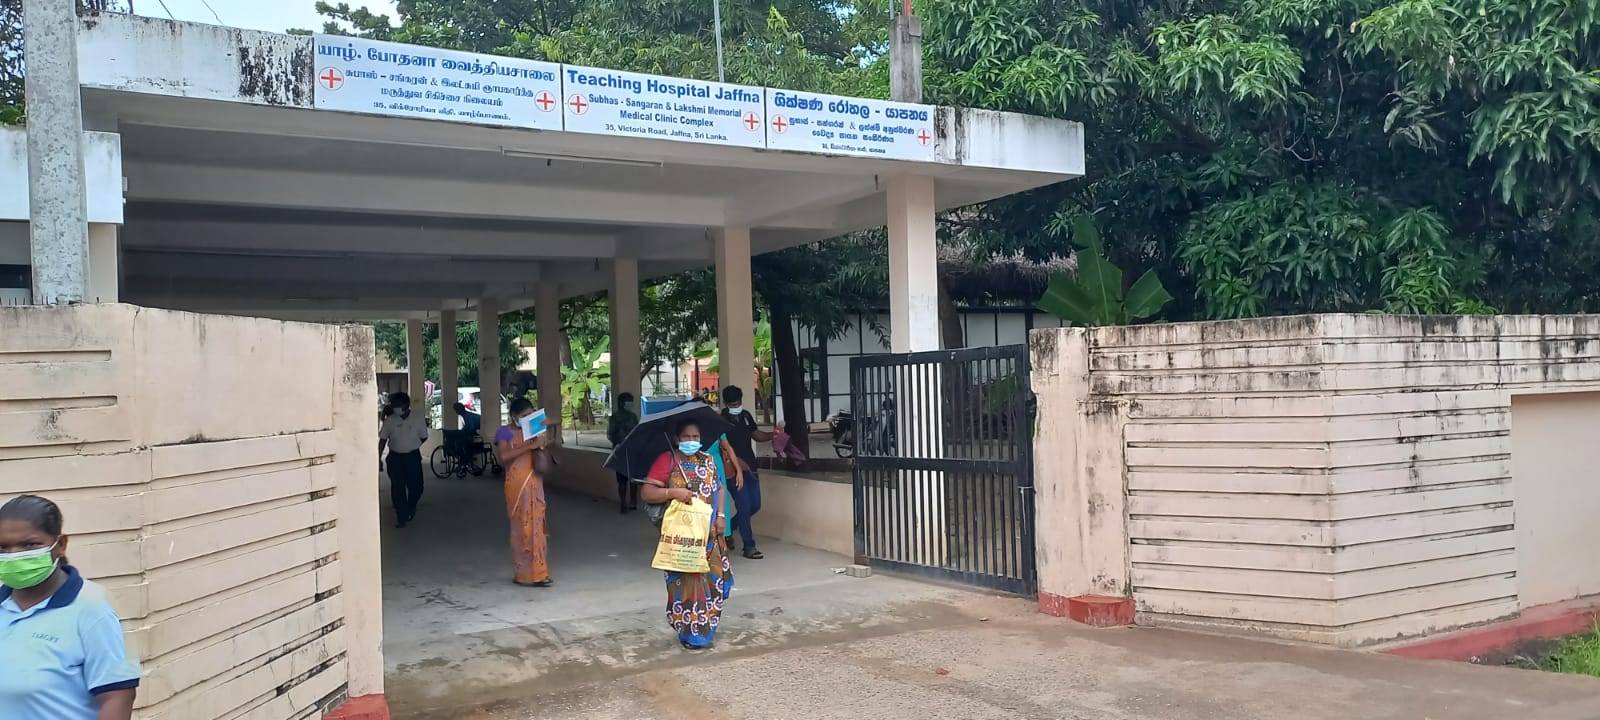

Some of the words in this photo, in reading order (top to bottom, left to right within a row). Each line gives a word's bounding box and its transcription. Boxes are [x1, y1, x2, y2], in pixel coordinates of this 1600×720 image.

[318, 43, 361, 62] யாழ்.
[367, 47, 437, 67] போதனா
[442, 59, 556, 82] வைத்தியசாலை
[430, 77, 438, 86] &
[567, 69, 642, 94] Teaching
[647, 79, 710, 98] Hospital
[715, 87, 760, 103] Jaffna
[463, 94, 503, 107] நிலையம்
[588, 93, 619, 105] Subhas
[626, 98, 663, 110] Sangaran
[666, 102, 672, 110] &
[674, 103, 706, 114] Lakshmi
[708, 106, 742, 117] Memorial
[620, 110, 653, 121] Medical
[655, 113, 678, 123] Clinic
[680, 116, 714, 127] Complex
[829, 100, 870, 119] රෝහල
[885, 107, 928, 122] යාපනය
[605, 124, 616, 132] 35,
[618, 125, 646, 134] Victoria
[648, 127, 668, 136] Road,
[670, 129, 693, 139] Jaffna,
[695, 131, 704, 139] Sri
[706, 132, 728, 141] Lanka.
[849, 121, 856, 130] &
